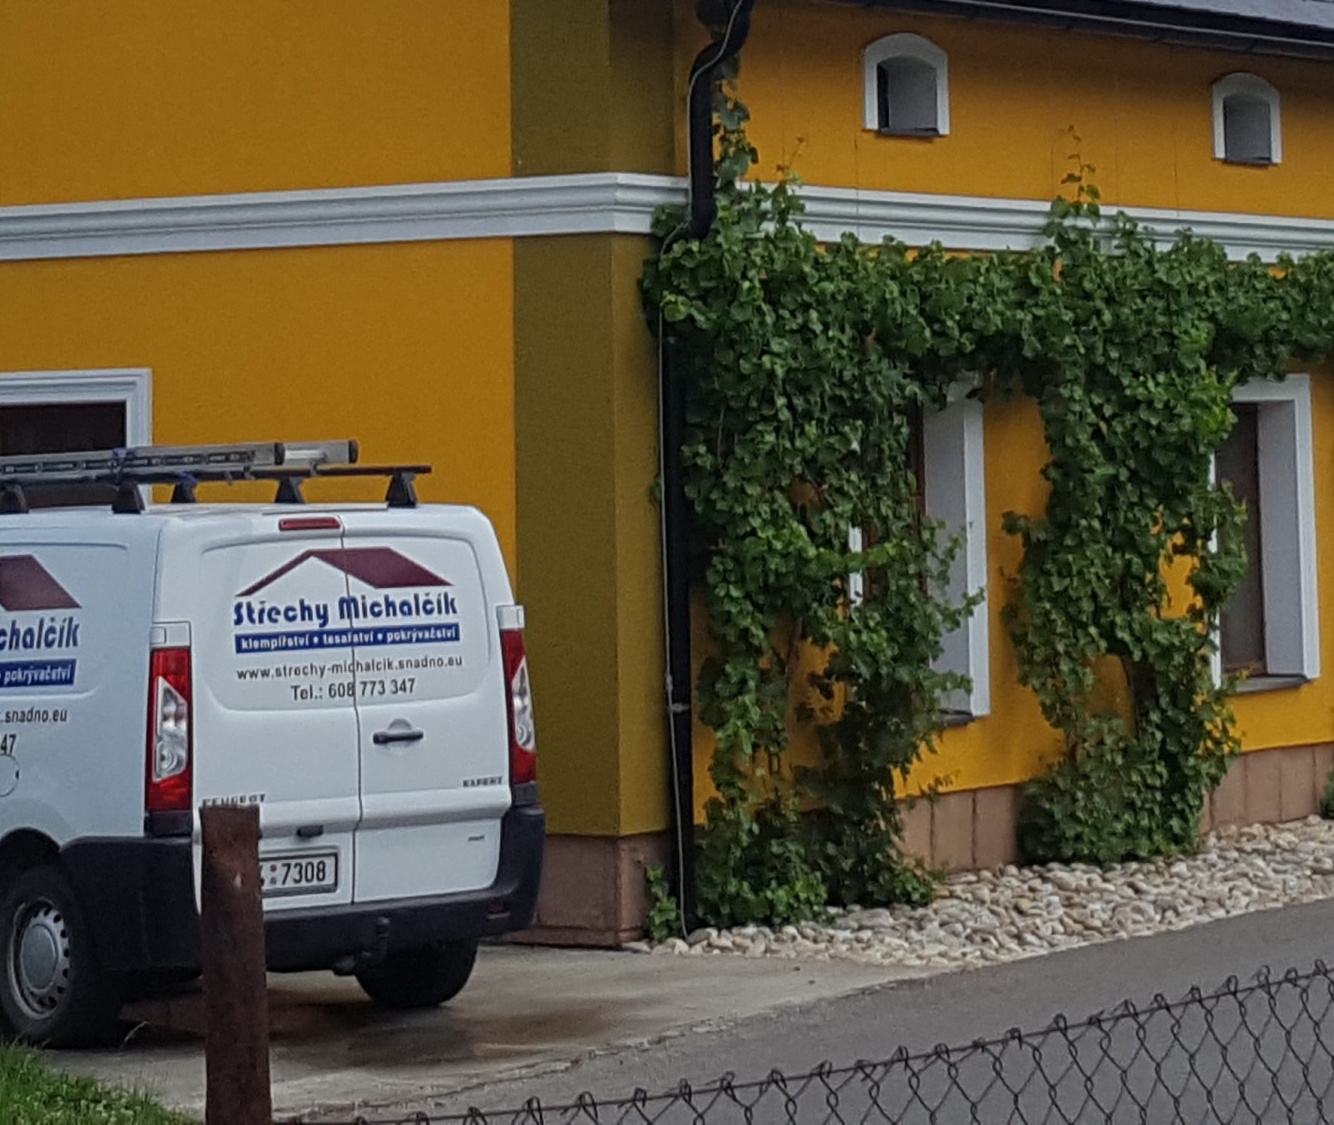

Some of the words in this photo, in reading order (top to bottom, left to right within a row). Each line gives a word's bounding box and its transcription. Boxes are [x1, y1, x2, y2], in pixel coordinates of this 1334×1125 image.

[233, 598, 329, 628] Střechy
[338, 591, 458, 620] Michalčík
[236, 655, 463, 680] www.strechy-michalcik.snadno.eu
[291, 685, 324, 701] Tel.:
[328, 682, 355, 698] 608
[360, 680, 386, 695] 773
[390, 678, 416, 694] 347
[281, 860, 326, 885] 7308
